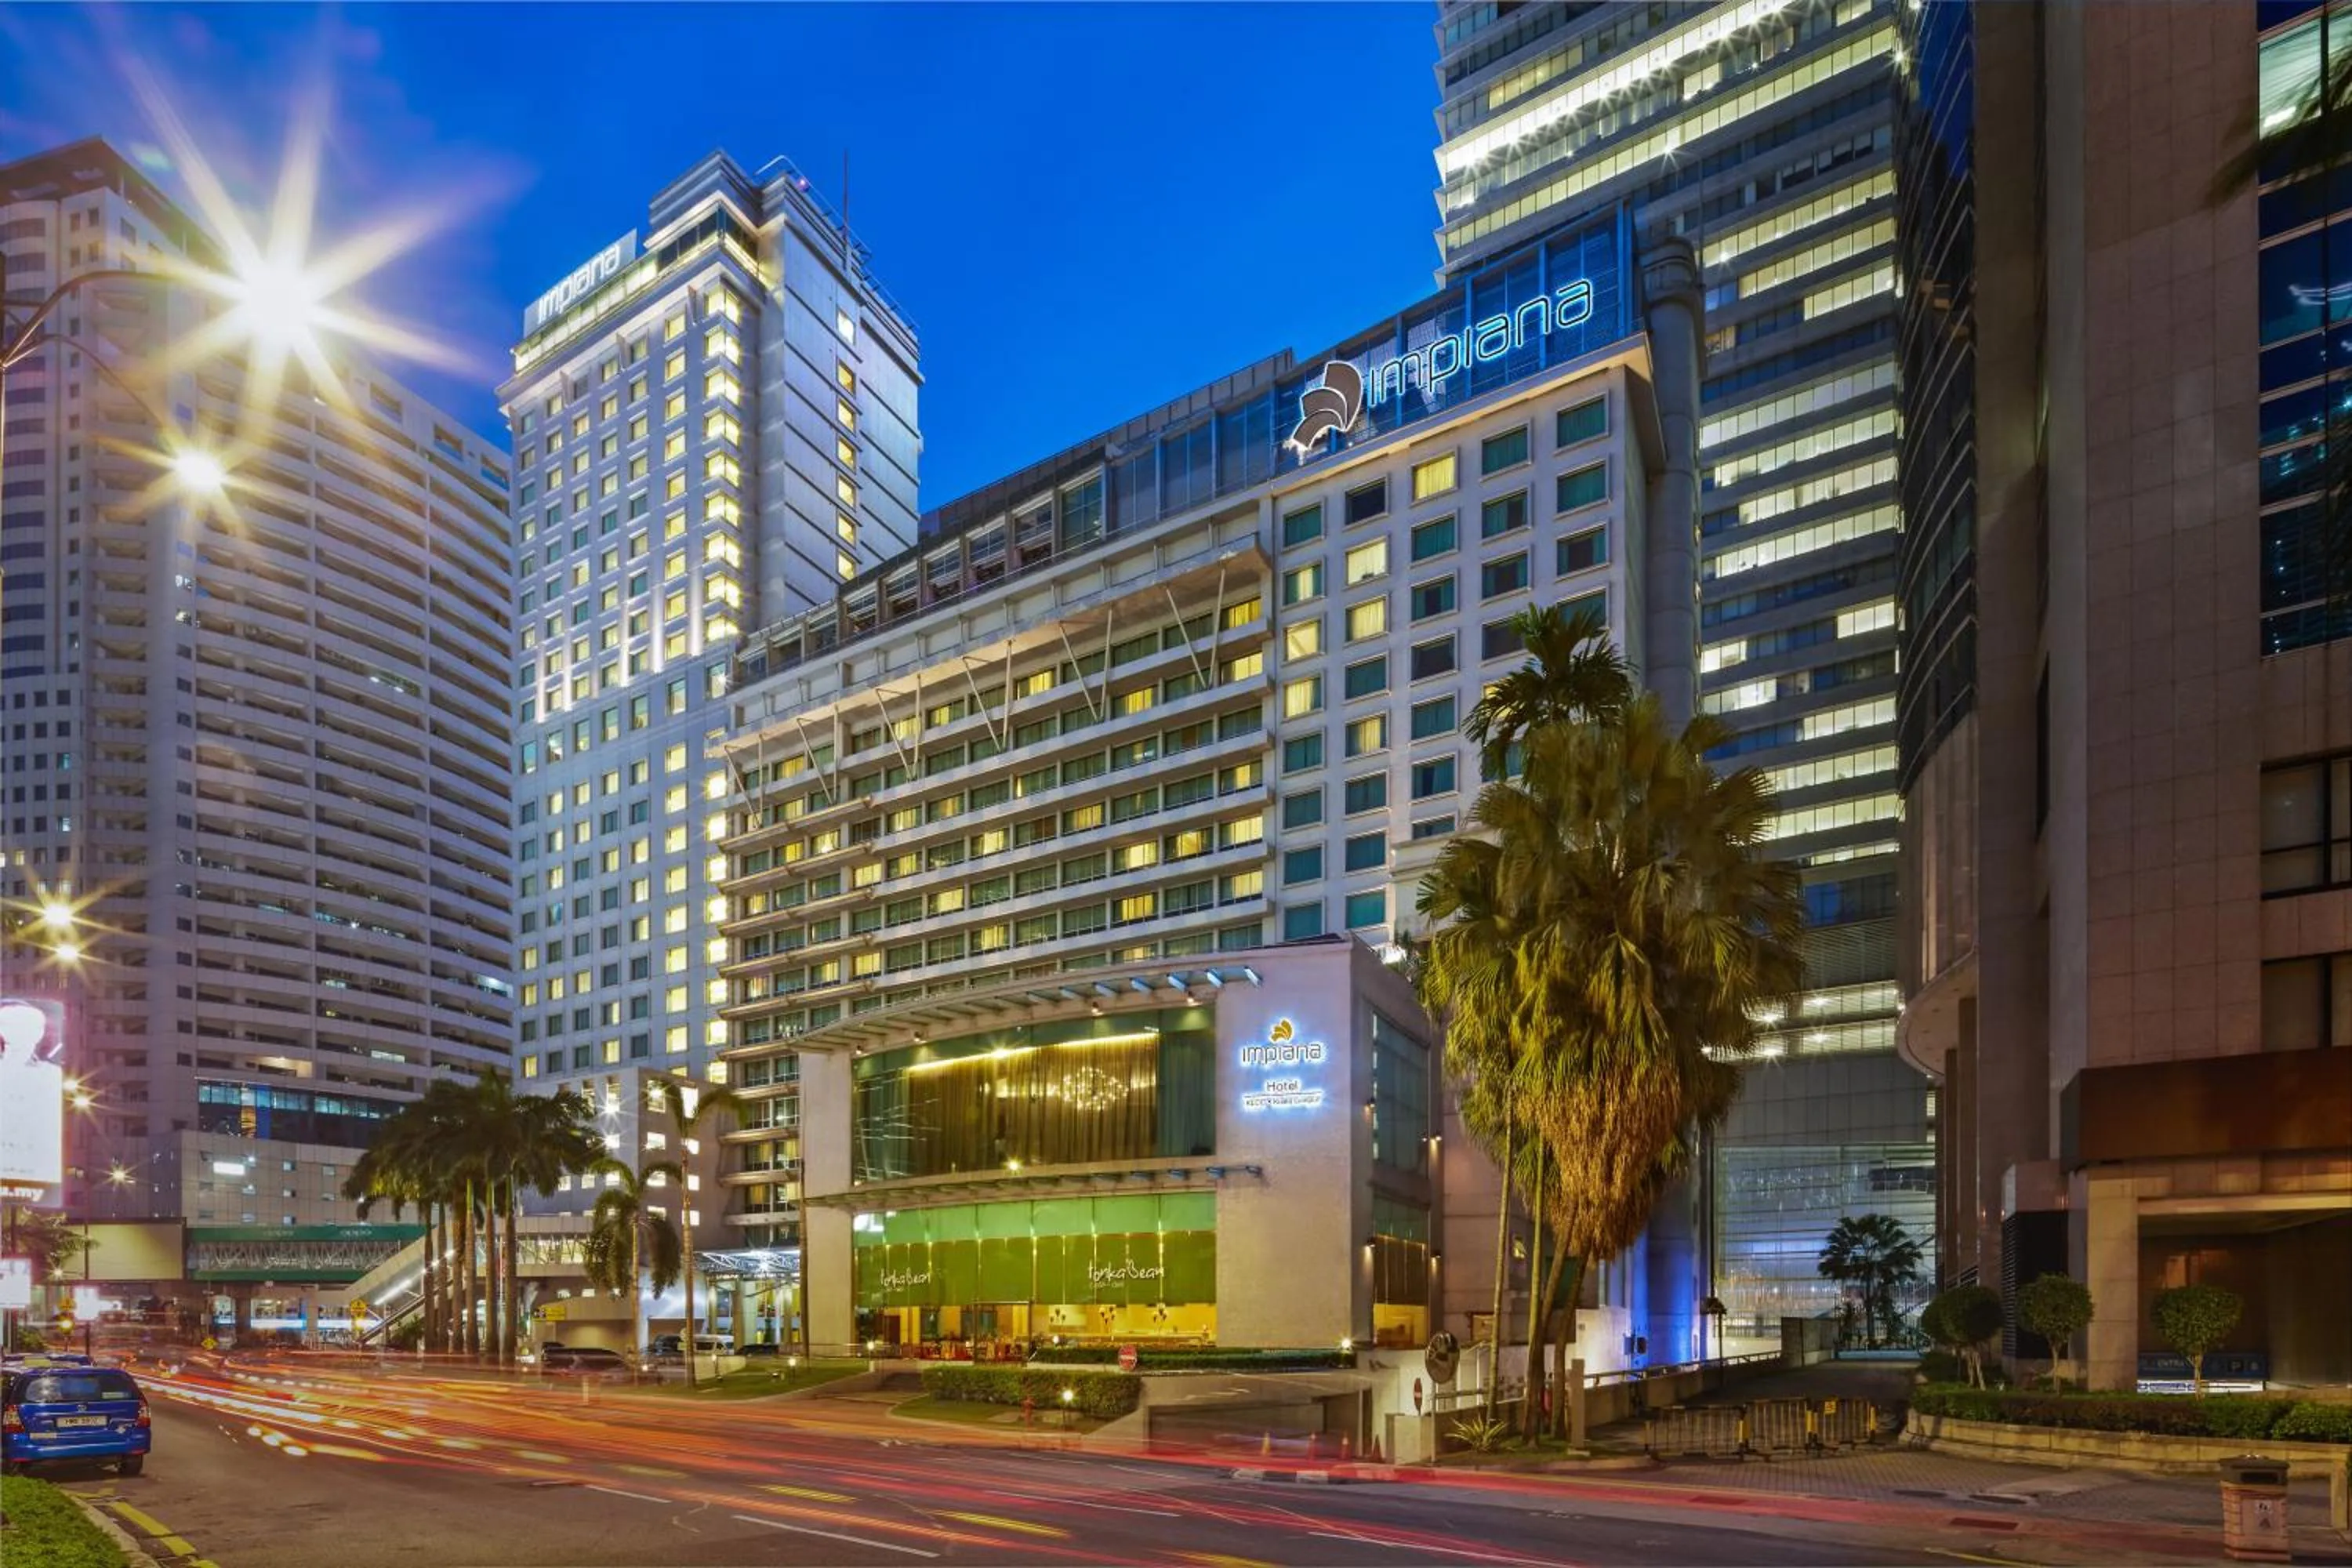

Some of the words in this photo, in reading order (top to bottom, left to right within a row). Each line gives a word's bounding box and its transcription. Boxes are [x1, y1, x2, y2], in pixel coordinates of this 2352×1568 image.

[1370, 278, 1593, 408] impiana
[1242, 1044, 1322, 1065] impiana
[1265, 1080, 1299, 1092] Hotel
